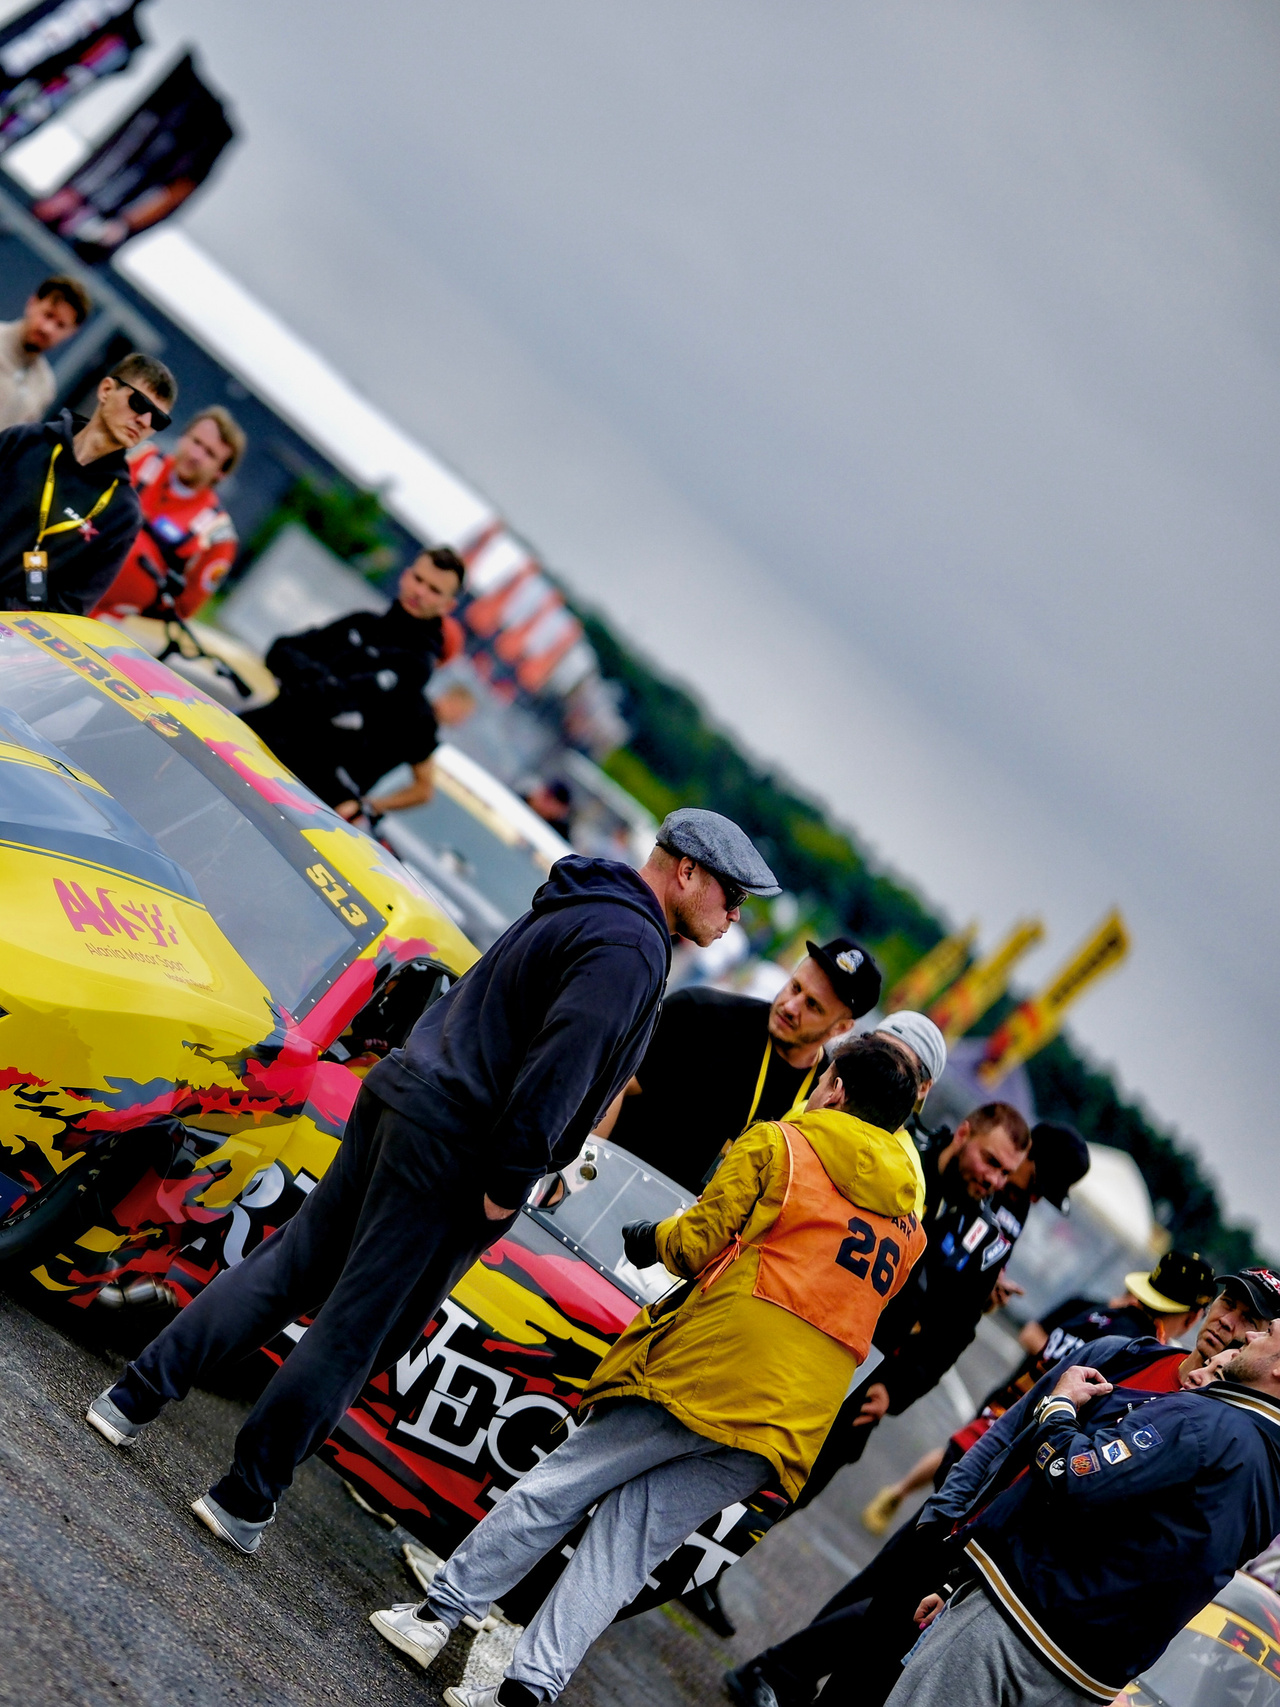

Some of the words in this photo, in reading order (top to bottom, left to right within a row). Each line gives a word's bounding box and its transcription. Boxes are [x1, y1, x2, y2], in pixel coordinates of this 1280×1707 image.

[12, 617, 141, 702] RDRC
[306, 863, 368, 926] 513
[84, 943, 128, 961] Alania
[124, 946, 160, 966] Motor
[157, 954, 190, 974] Sport
[834, 1216, 901, 1298] 26
